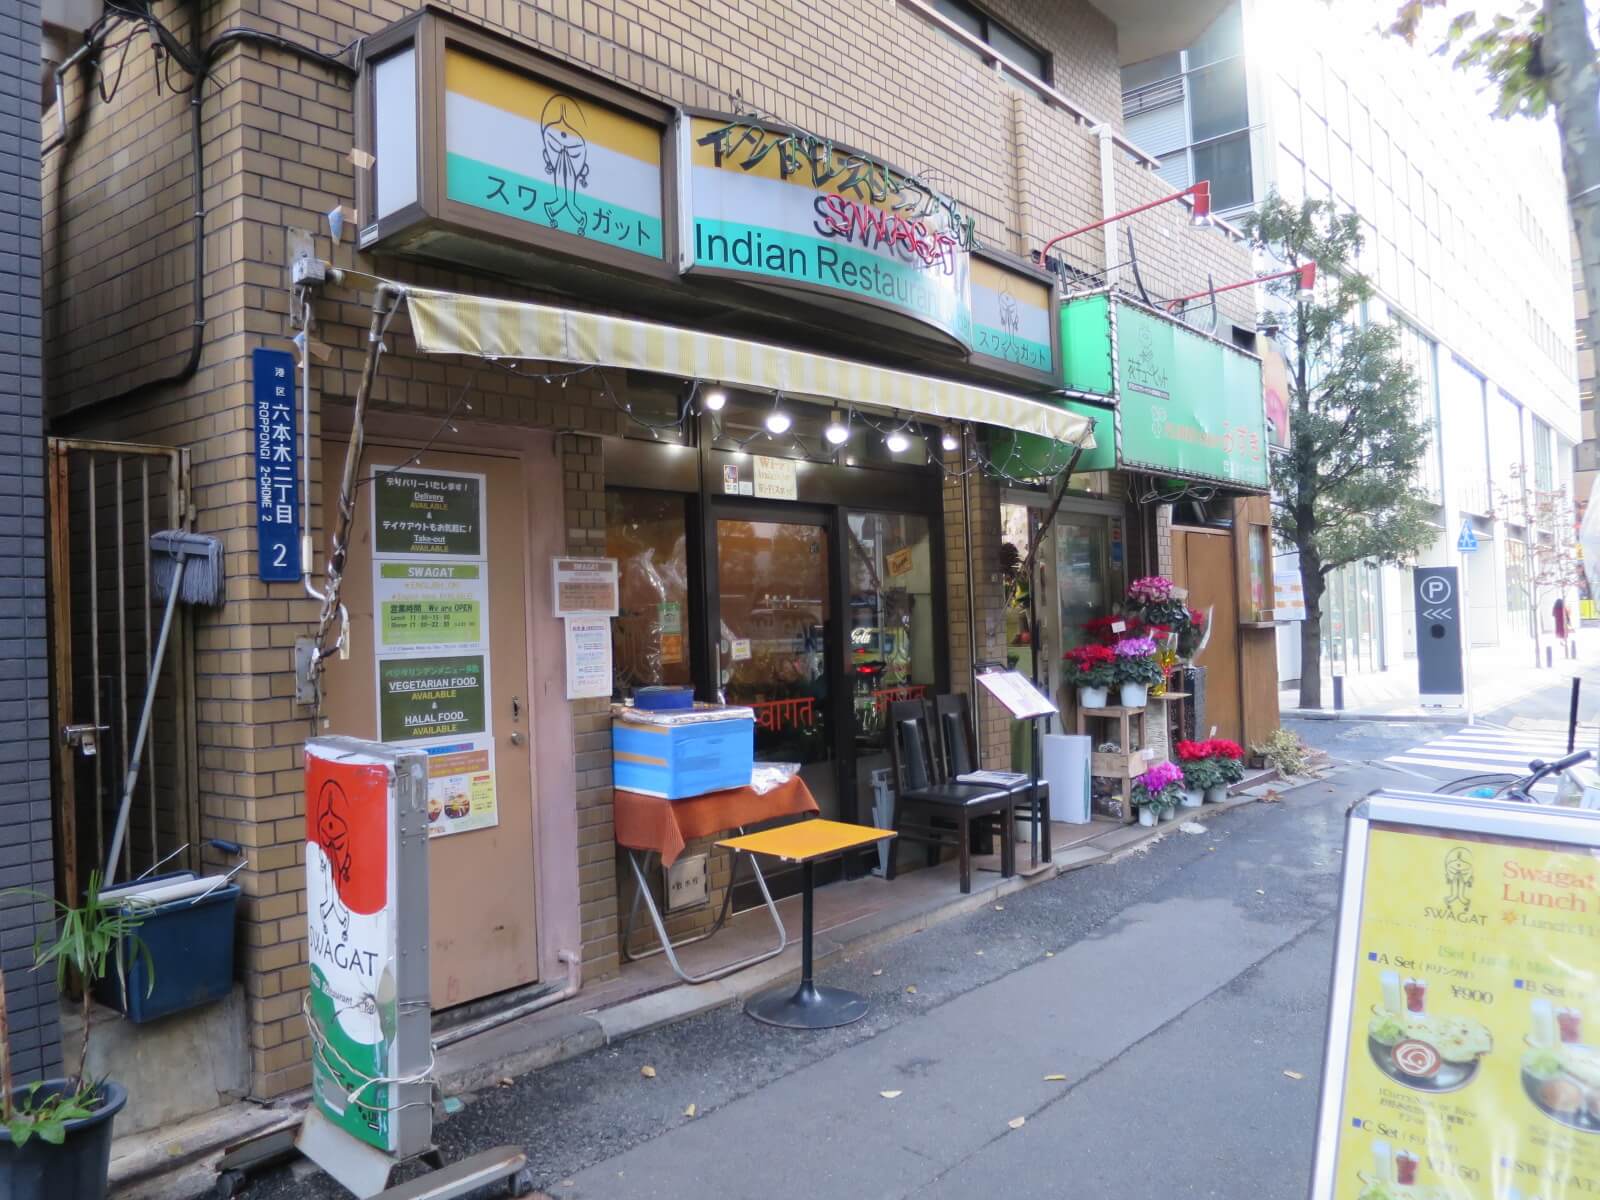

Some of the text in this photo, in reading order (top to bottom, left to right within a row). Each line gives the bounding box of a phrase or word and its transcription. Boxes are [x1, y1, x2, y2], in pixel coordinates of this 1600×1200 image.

[695, 223, 946, 317] Indian Restauran
[258, 401, 272, 522] ROPPONGI 2-CHOME 2
[272, 367, 293, 567] 港区 六本木二丁目 2
[414, 491, 445, 502] Delivery
[409, 501, 449, 511] AVAILABLE
[413, 534, 446, 544] Take-out
[410, 544, 449, 553] AVAILABLE
[407, 567, 455, 577] SWAGAT
[1428, 582, 1444, 599] P
[388, 676, 477, 691] VEGETARIAN FOOD
[411, 689, 457, 701] AVAILABLE
[404, 711, 464, 725] HALAL FOOD
[411, 724, 457, 736] AVAILABLE
[1502, 860, 1596, 890] Swagat
[1502, 883, 1587, 913] Lunch
[1423, 906, 1489, 927] SWAGAT
[1378, 953, 1390, 965] A
[1394, 955, 1416, 970] Set
[1362, 1119, 1398, 1138] C Set
